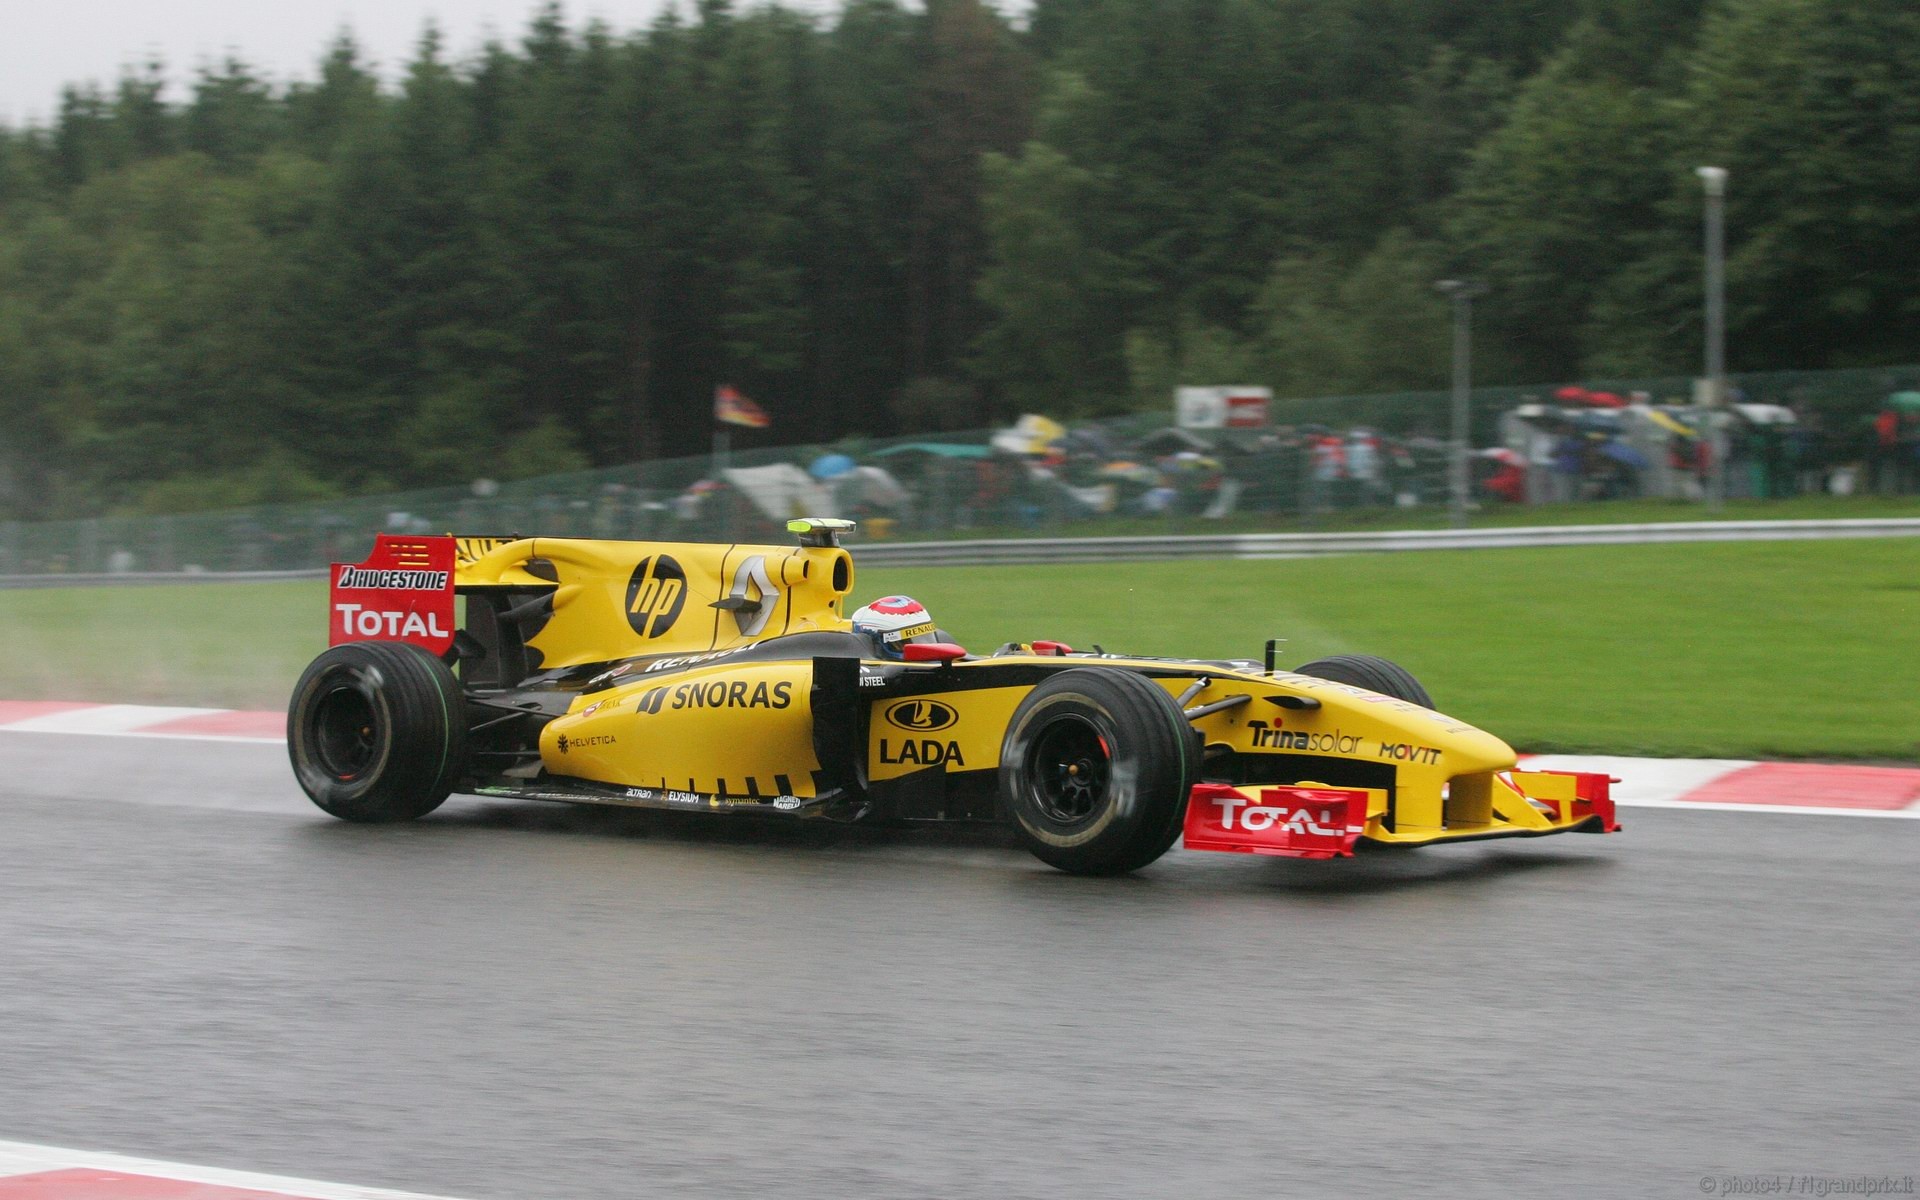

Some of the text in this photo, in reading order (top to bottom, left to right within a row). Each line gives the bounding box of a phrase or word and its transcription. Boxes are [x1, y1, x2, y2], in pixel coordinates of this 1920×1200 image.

[337, 565, 448, 590] BRIDGESTONE
[628, 553, 683, 638] hp
[336, 604, 449, 638] TOTAL
[864, 676, 886, 687] STEEL
[671, 681, 793, 710] SNORAS
[569, 735, 617, 747] HELVETICA
[880, 739, 965, 766] LADA
[668, 792, 700, 803] ELYSIUM
[1212, 798, 1363, 836] TOTAL
